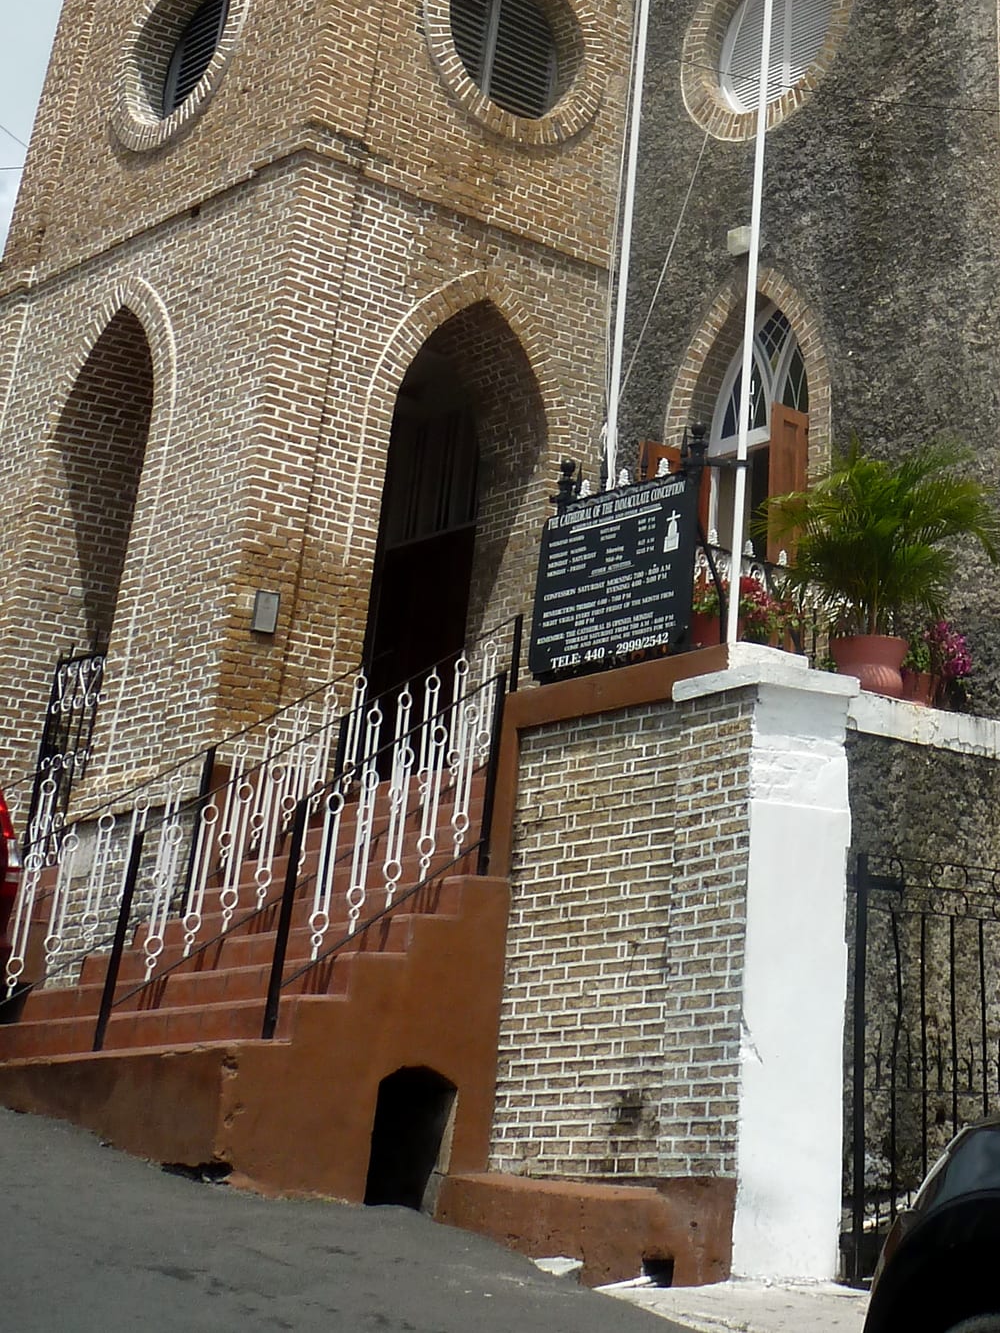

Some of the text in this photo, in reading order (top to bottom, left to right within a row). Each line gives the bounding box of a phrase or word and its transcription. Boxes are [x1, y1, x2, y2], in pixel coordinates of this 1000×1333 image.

[548, 516, 560, 530] THE
[560, 507, 592, 527] CATHEDRAL
[593, 504, 601, 518] OF
[602, 501, 614, 515] THE
[614, 490, 650, 511] IMMACULATE
[651, 480, 686, 501] CONCEPTION
[577, 581, 606, 594] SATURDAY
[606, 574, 633, 586] MORNING
[605, 604, 623, 613] FRIDAY
[631, 598, 642, 607] THE
[641, 594, 660, 604] MONTH
[660, 590, 675, 600] FROM
[565, 629, 577, 639] THE
[577, 622, 605, 635] CATHEDRAL
[632, 611, 654, 623] MONDAY
[580, 639, 592, 649] AND
[653, 623, 664, 632] FOR
[589, 628, 614, 639] SATURDAY
[550, 652, 582, 669] TELE:
[584, 647, 605, 661] 440
[615, 632, 669, 655] 2999/2542
